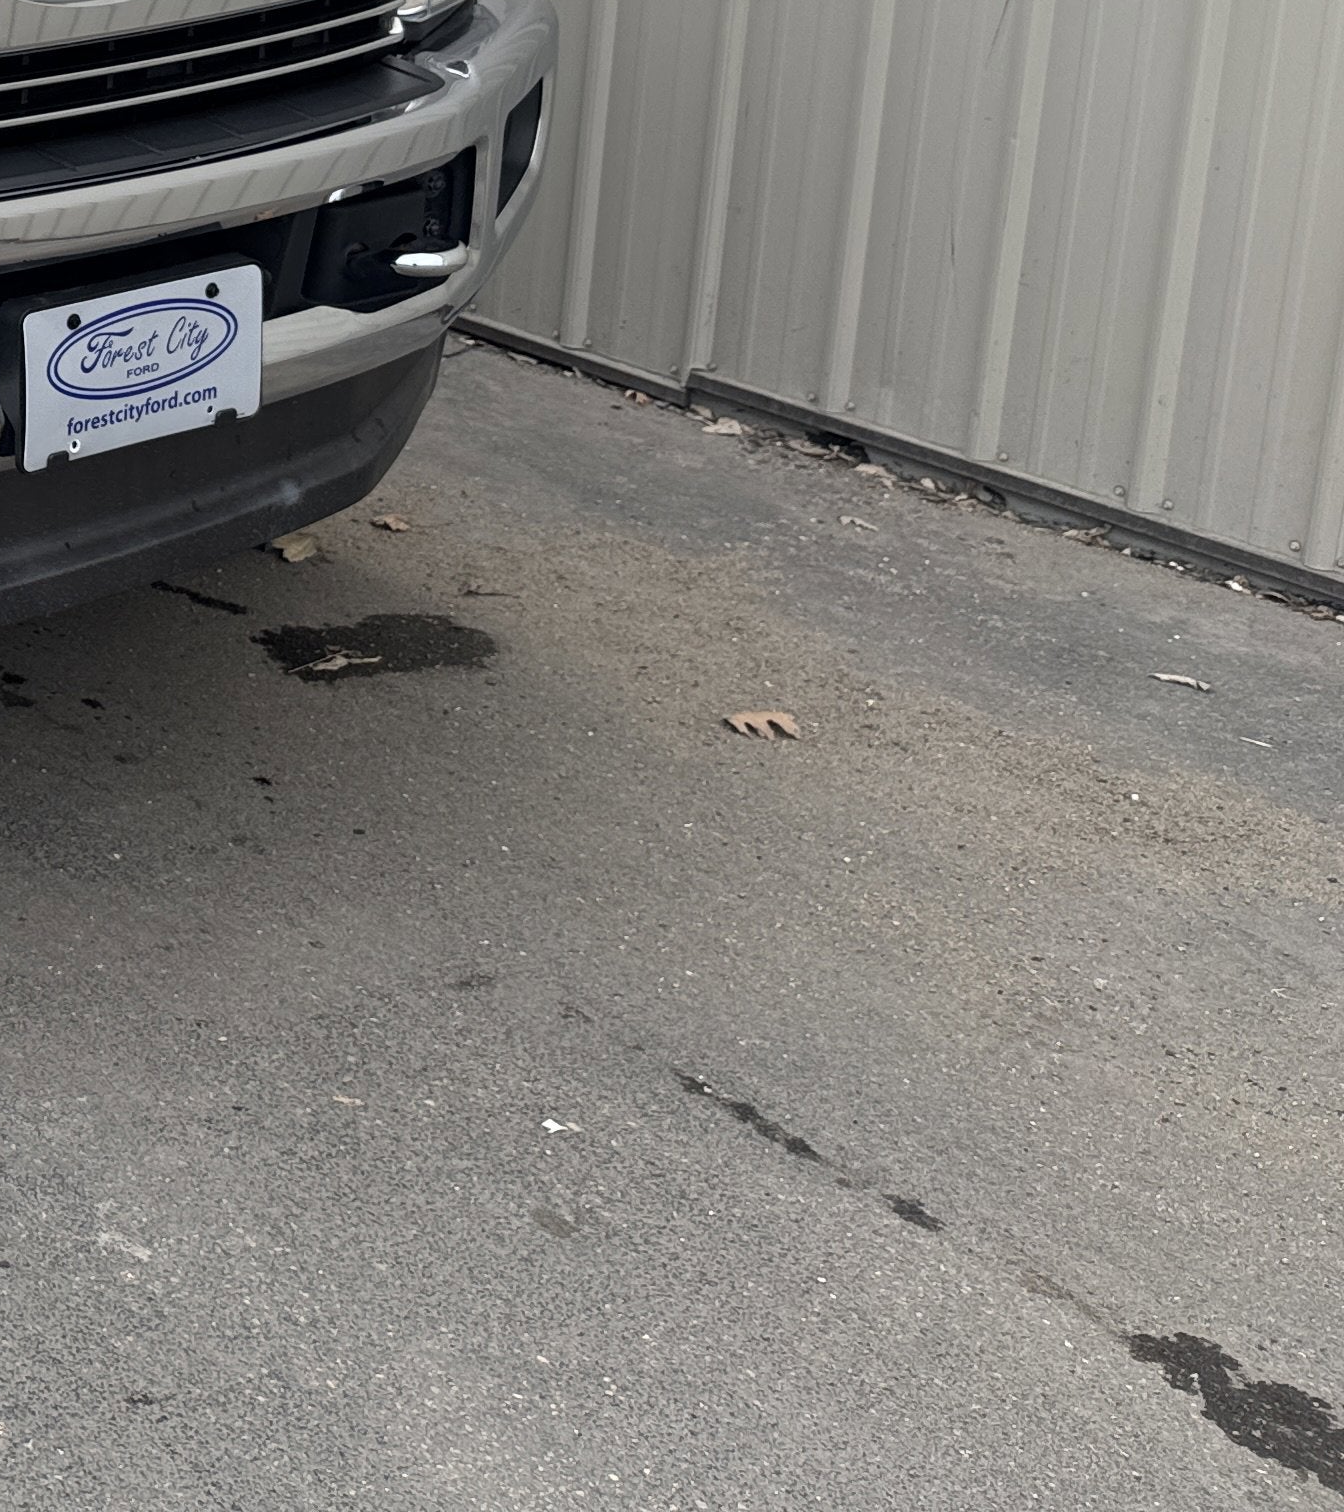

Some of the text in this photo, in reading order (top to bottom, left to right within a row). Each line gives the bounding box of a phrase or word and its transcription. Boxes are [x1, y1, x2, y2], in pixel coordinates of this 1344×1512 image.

[80, 315, 209, 374] Forest City
[126, 362, 160, 378] FORD
[66, 385, 218, 436] forestcityford.com
